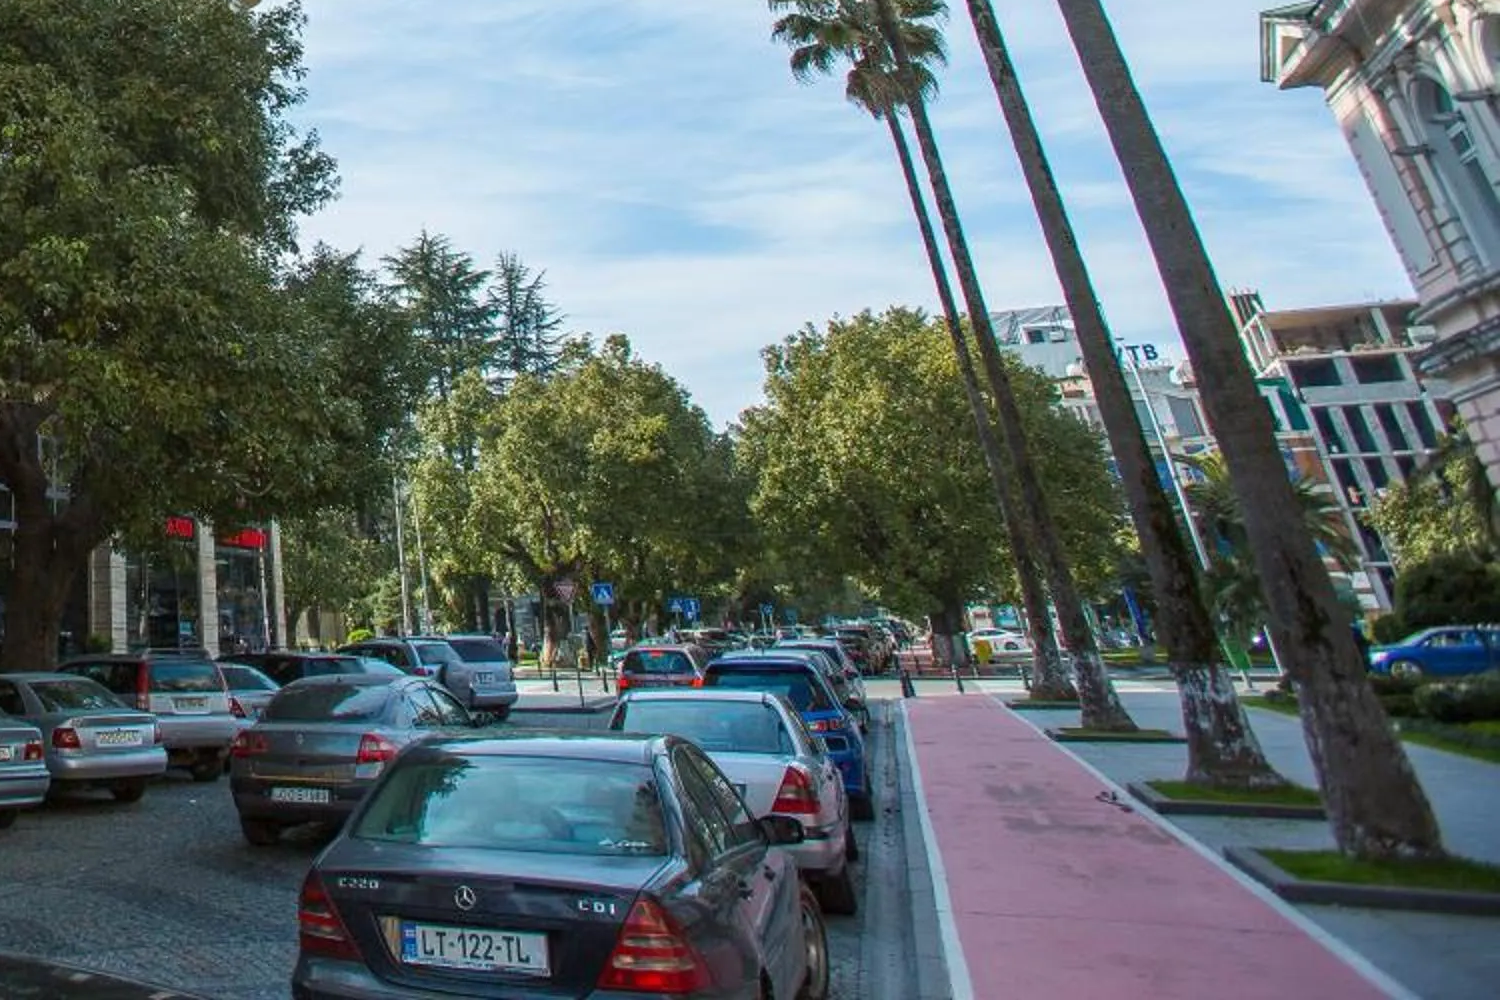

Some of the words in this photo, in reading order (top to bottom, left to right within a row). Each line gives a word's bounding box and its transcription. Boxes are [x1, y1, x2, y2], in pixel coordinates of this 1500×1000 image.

[338, 877, 379, 889] C220
[577, 899, 616, 915] CDI
[421, 929, 532, 963] LT-122-TL
